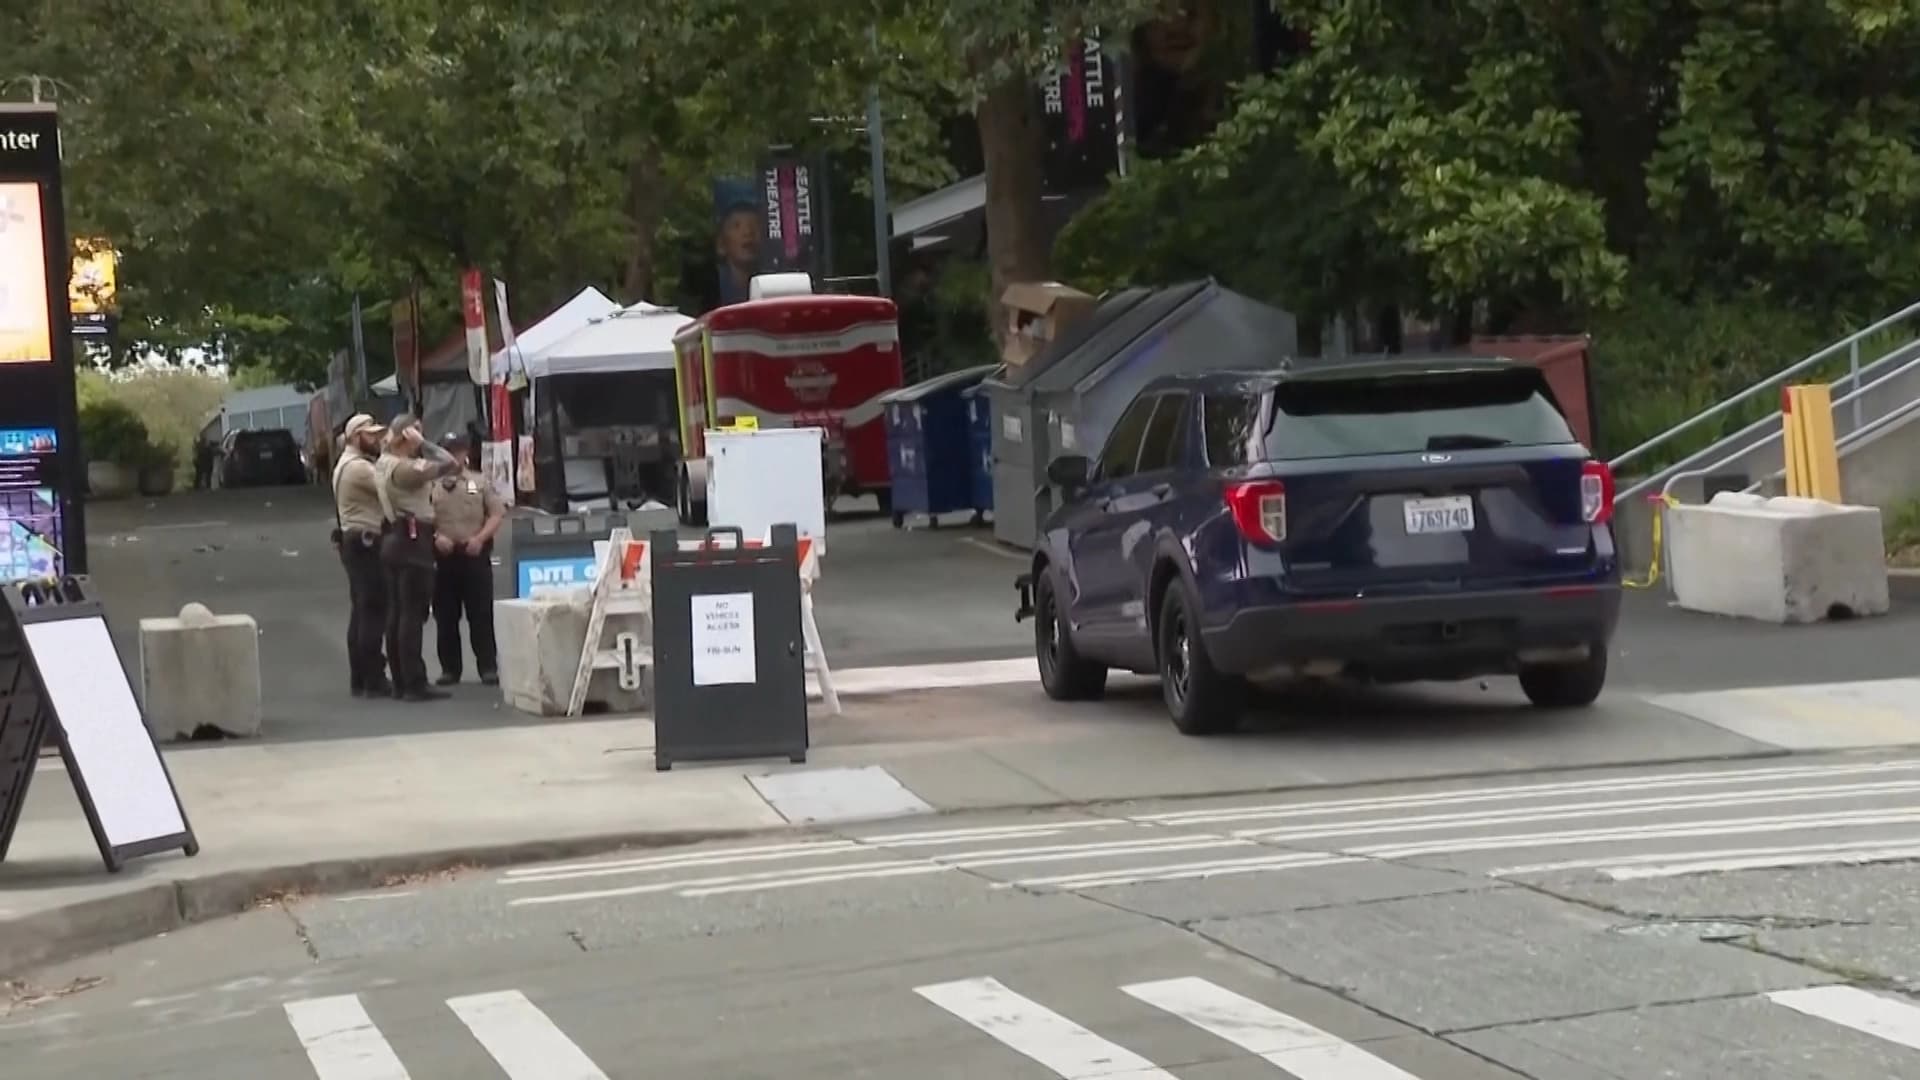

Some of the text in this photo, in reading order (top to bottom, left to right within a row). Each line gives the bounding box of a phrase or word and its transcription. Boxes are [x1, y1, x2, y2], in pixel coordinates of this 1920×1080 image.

[1084, 25, 1104, 107] EATTLE
[765, 167, 782, 239] THEATRE
[796, 165, 812, 235] SEATTLE
[715, 601, 729, 609] NO
